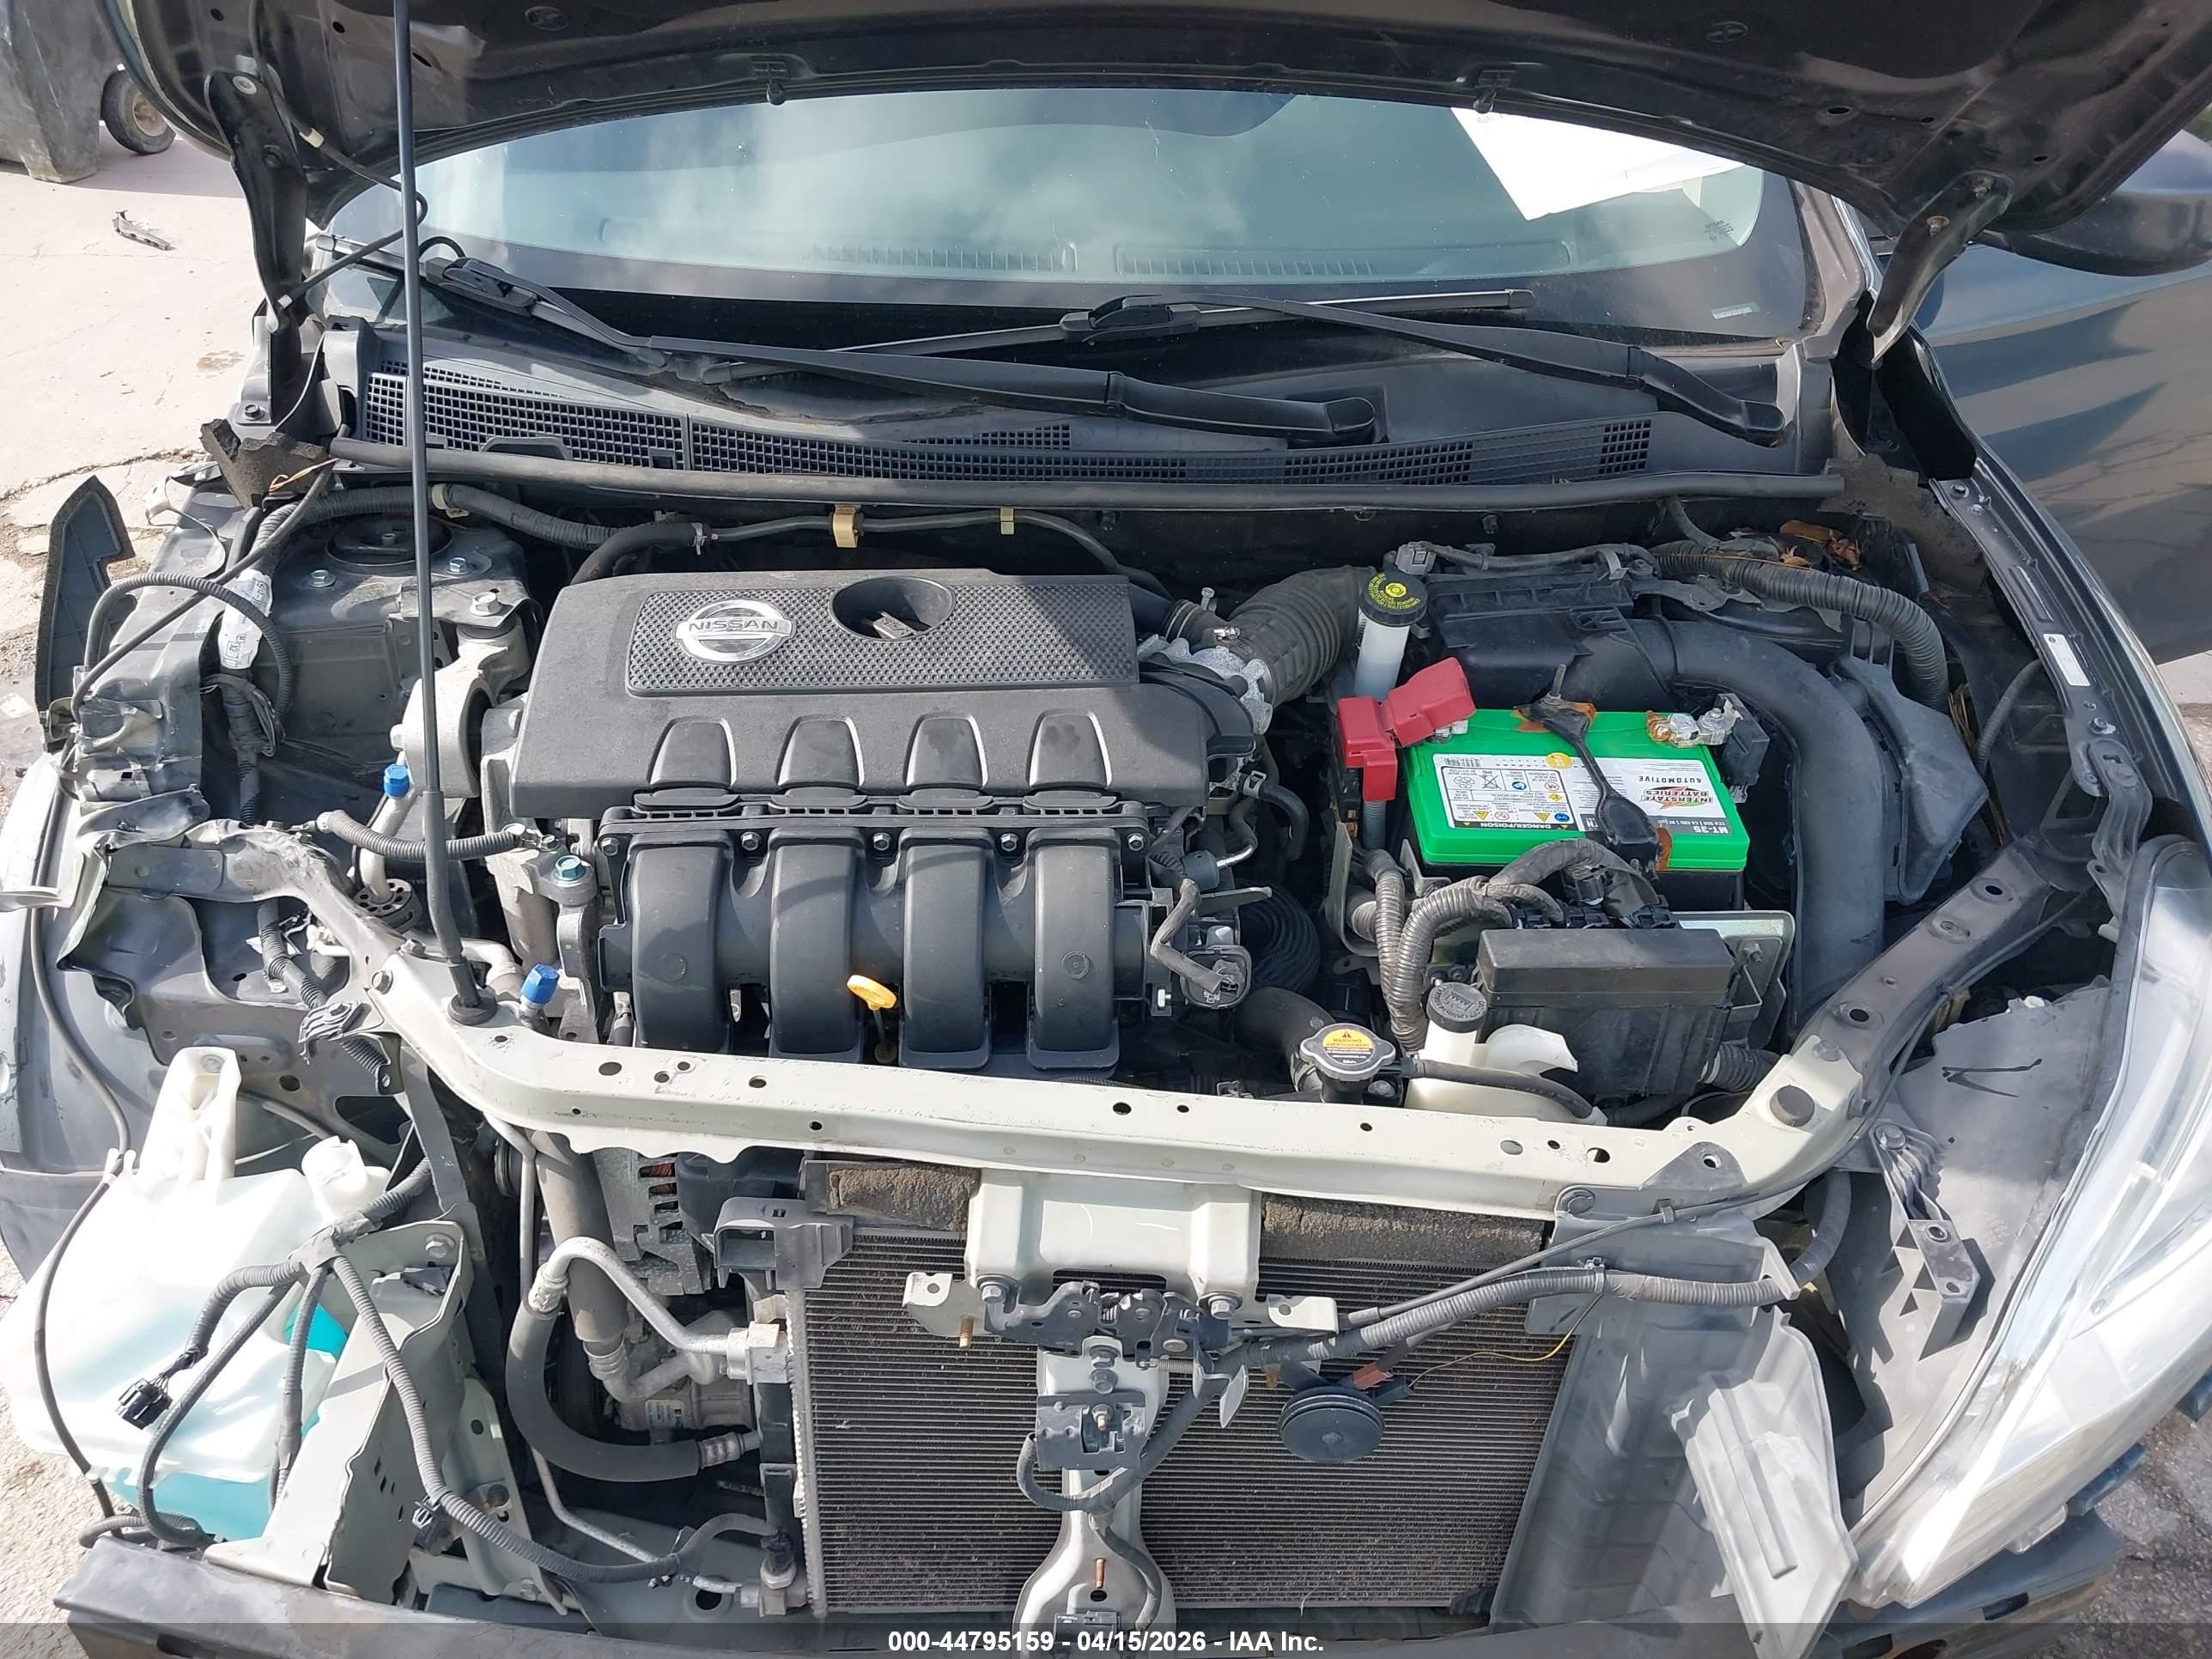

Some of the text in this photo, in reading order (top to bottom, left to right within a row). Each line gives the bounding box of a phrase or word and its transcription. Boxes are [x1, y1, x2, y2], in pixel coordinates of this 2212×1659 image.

[689, 619, 779, 632] NISSAN
[1641, 795, 1712, 804] INTERSTATE
[1693, 825, 1729, 834] MT-35
